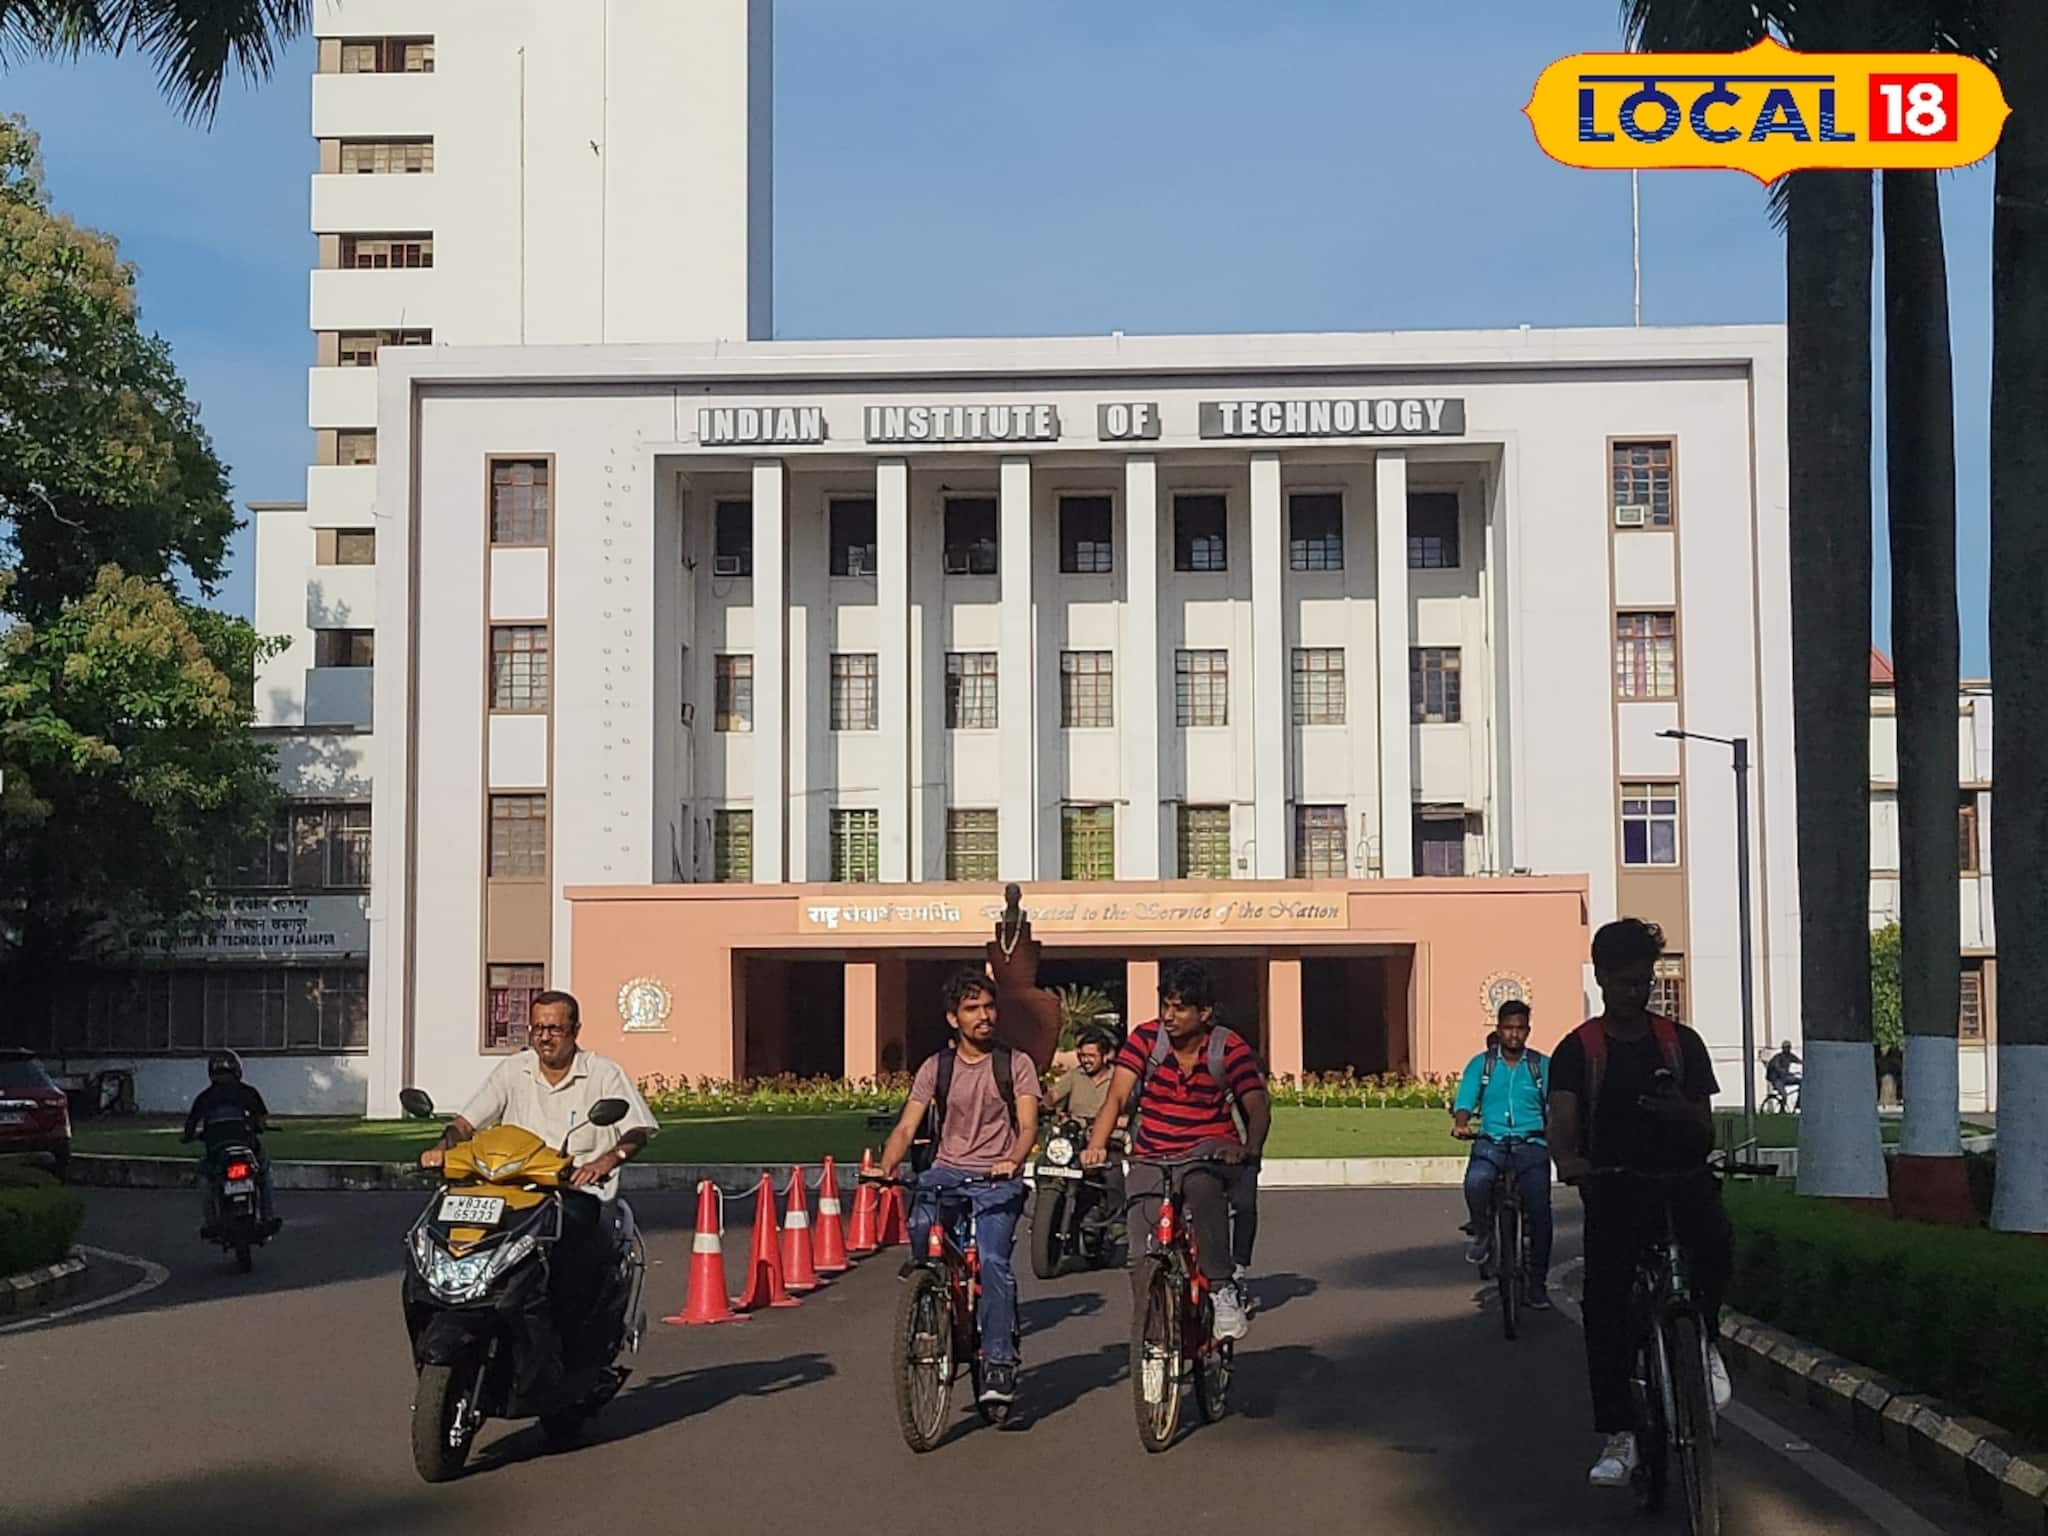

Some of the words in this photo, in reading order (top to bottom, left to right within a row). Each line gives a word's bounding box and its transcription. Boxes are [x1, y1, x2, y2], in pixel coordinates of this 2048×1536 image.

[700, 408, 821, 442] INDIAN
[869, 405, 1051, 440] INSTITUTE
[1106, 404, 1149, 437] OF
[1218, 399, 1446, 435] TECHNOLOGY
[1082, 906, 1098, 921] to
[1102, 903, 1130, 921] the
[1215, 902, 1238, 925] of
[1238, 902, 1264, 920] the
[1267, 900, 1339, 919] Nation
